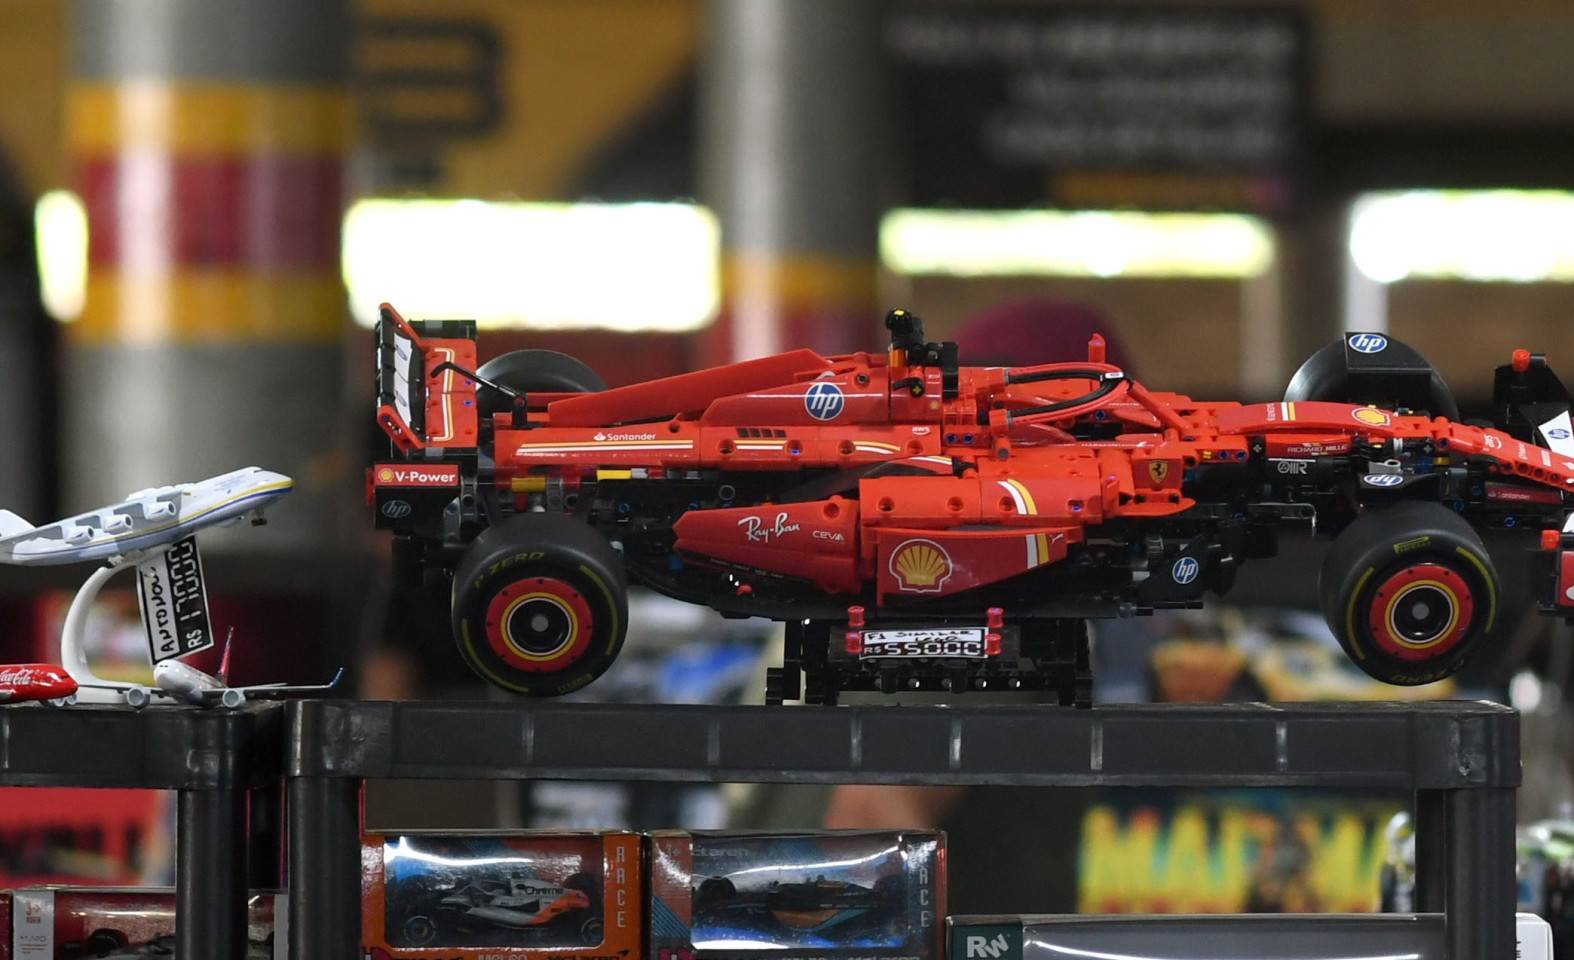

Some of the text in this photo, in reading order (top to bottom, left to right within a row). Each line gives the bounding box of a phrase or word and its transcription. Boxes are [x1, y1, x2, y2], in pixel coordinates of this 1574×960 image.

[810, 382, 840, 420] hp
[607, 433, 656, 441] Santander
[395, 471, 455, 483] V-Power
[738, 513, 800, 543] Ray-Ban
[1175, 558, 1197, 584] hp
